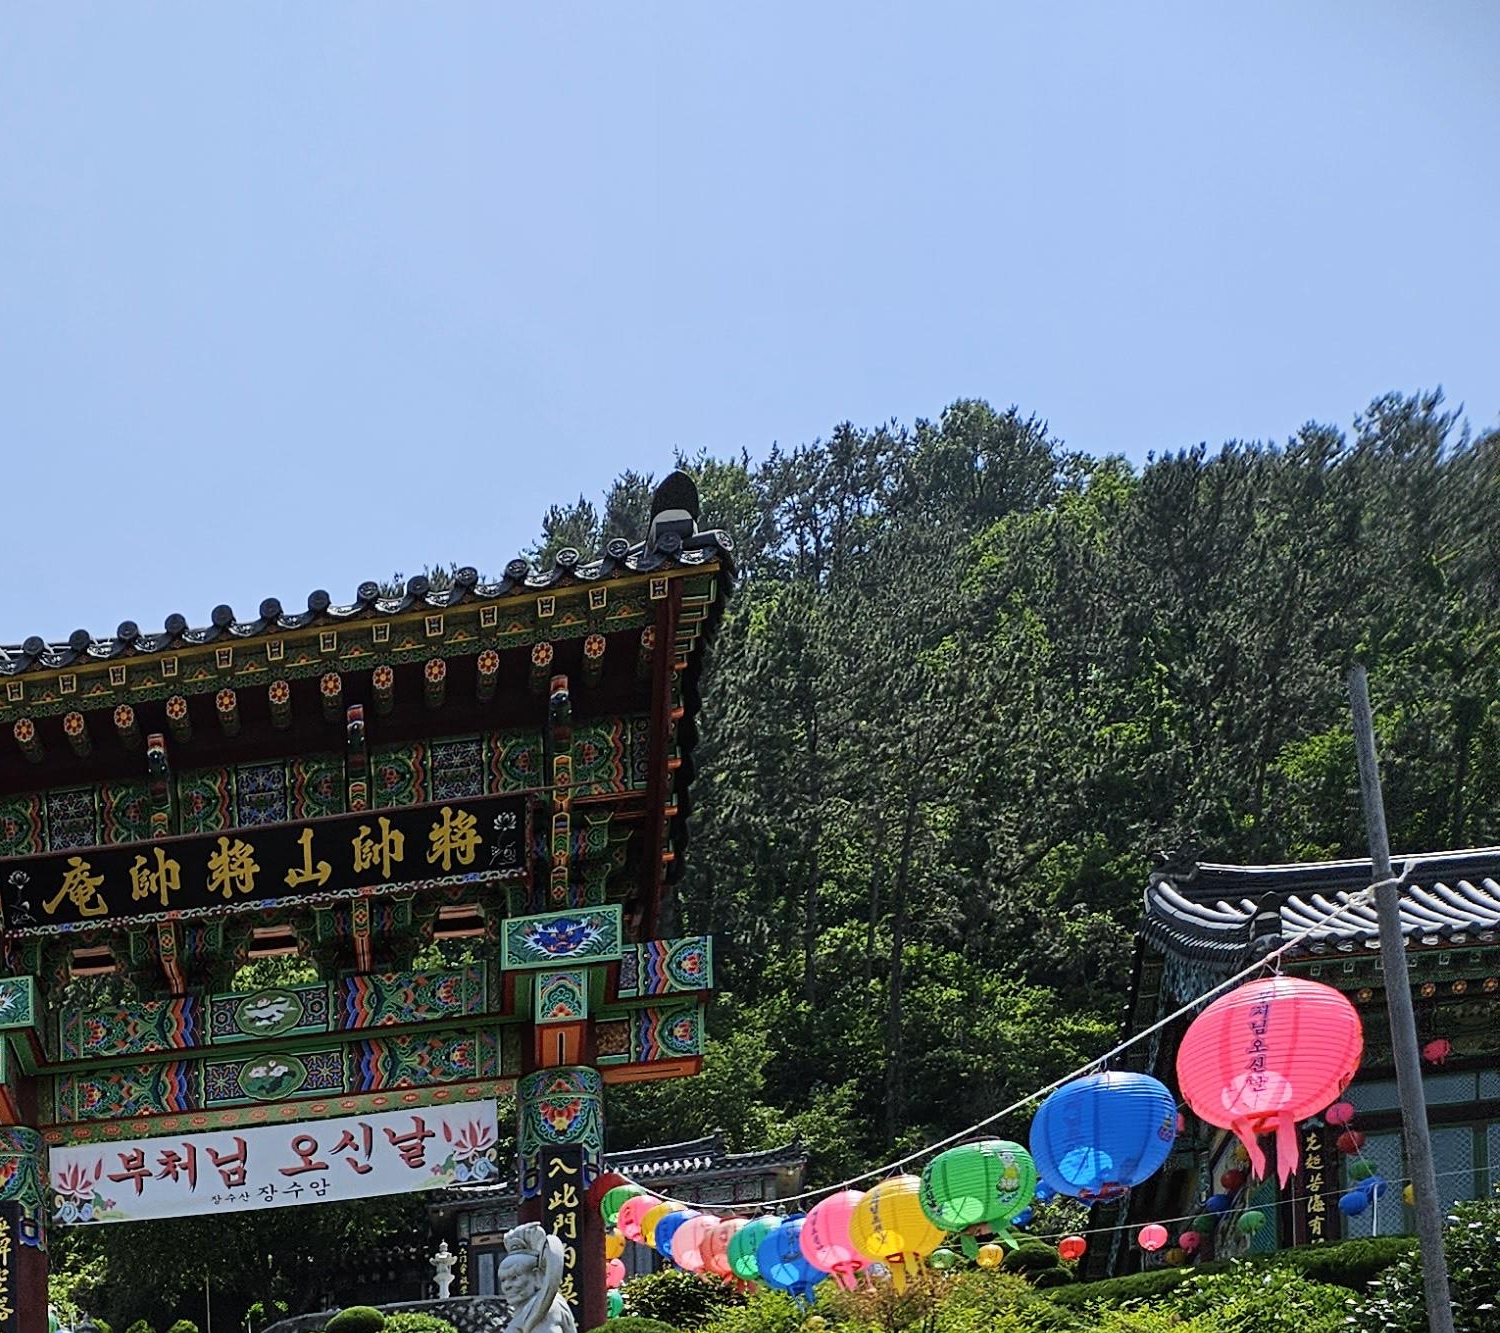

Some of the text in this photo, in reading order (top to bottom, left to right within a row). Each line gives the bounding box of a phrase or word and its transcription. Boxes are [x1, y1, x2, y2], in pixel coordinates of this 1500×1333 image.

[106, 1115, 436, 1197] 부처님 오신날
[210, 1177, 331, 1206] 장수산 장수암
